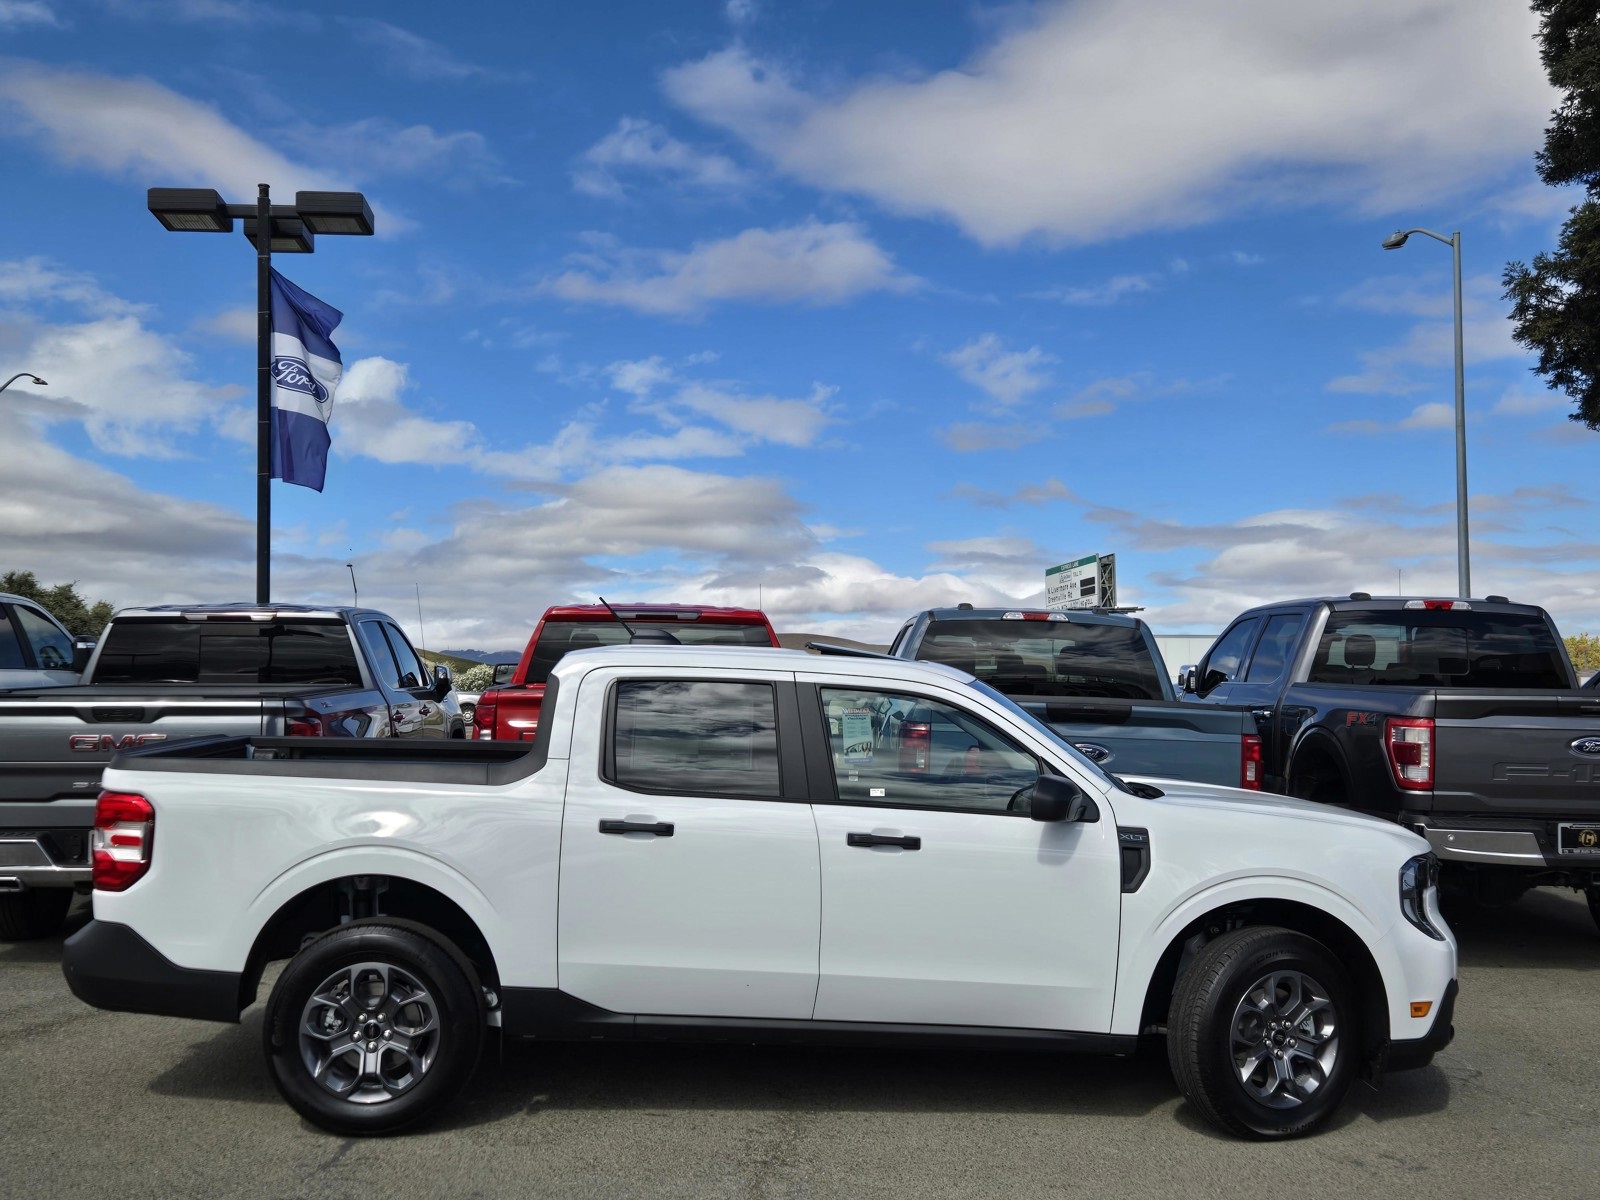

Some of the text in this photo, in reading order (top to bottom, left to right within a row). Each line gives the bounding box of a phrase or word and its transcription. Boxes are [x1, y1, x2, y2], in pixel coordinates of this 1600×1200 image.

[276, 360, 315, 394] Ford
[1051, 583, 1069, 594] Livermore
[1048, 591, 1073, 603] Greenville Rd
[1346, 711, 1378, 728] FX4
[1120, 833, 1147, 841] XLT
